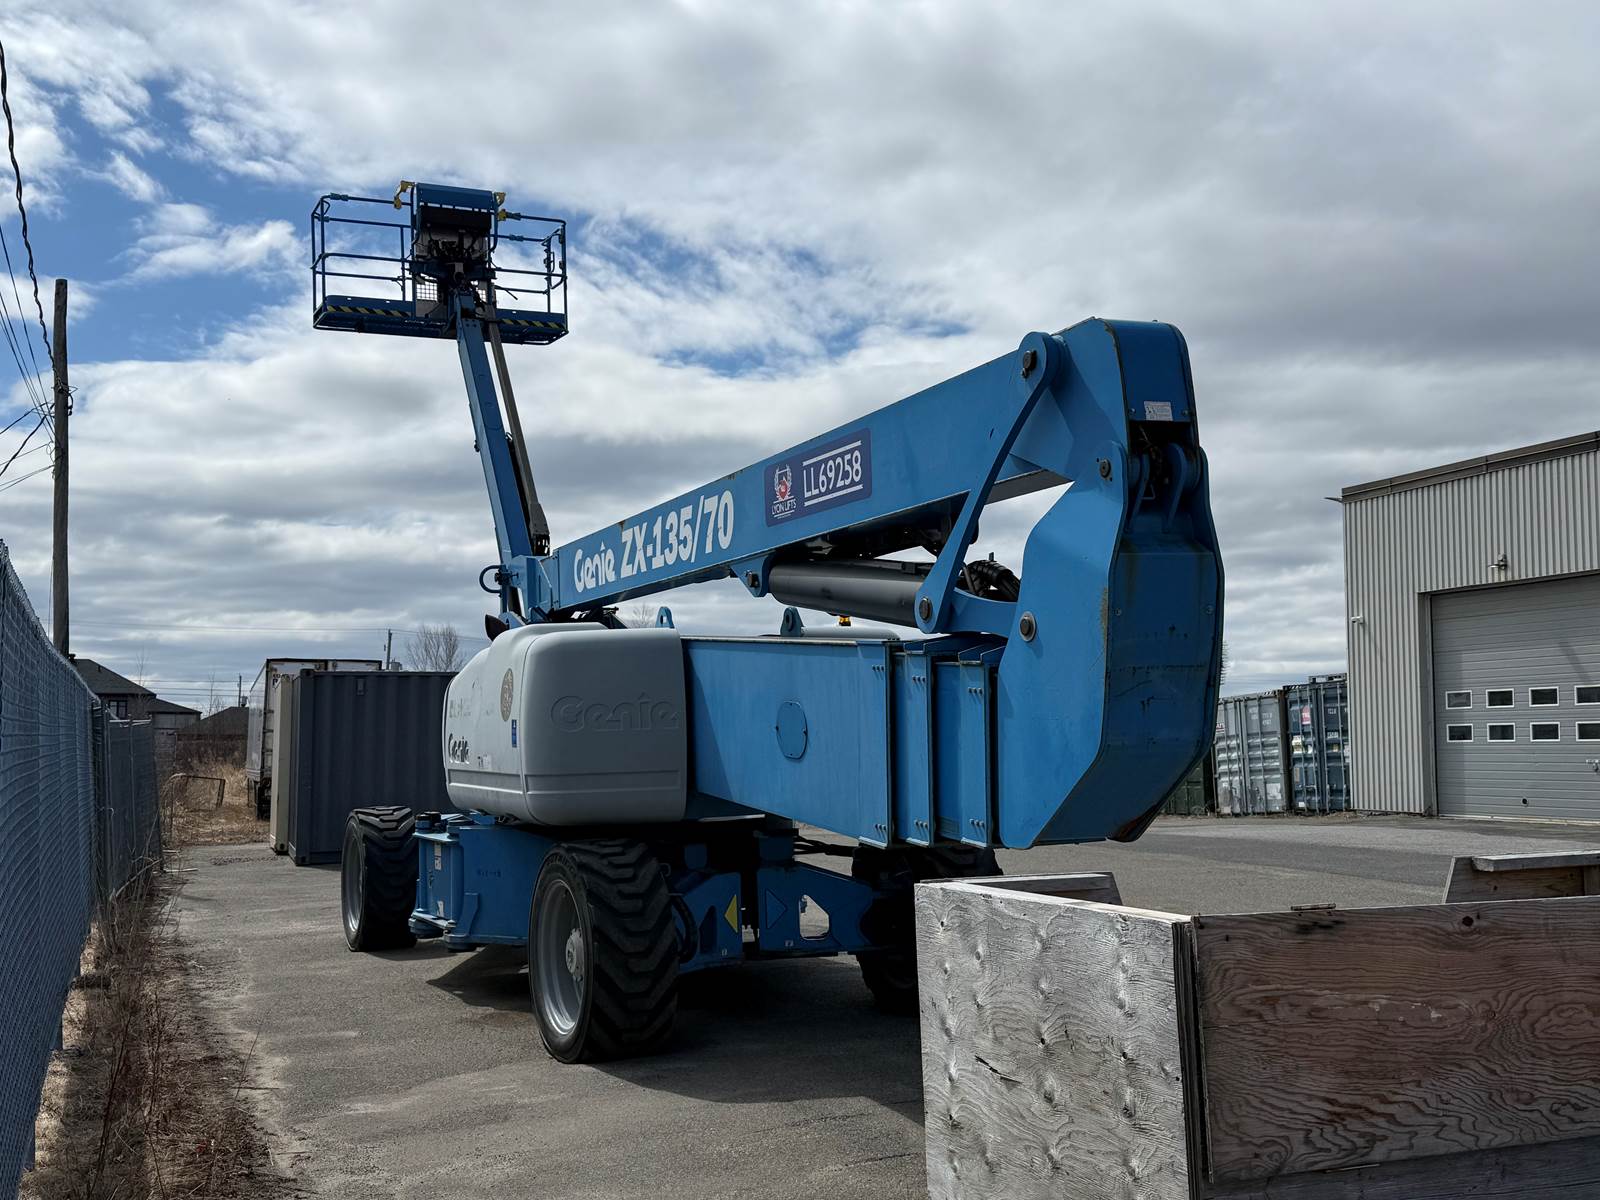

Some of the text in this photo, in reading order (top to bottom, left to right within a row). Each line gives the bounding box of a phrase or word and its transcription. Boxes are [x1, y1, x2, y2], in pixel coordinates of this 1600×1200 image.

[803, 449, 862, 498] LL69258
[574, 489, 735, 593] Genie ZX-135/70
[550, 692, 680, 732] Genie
